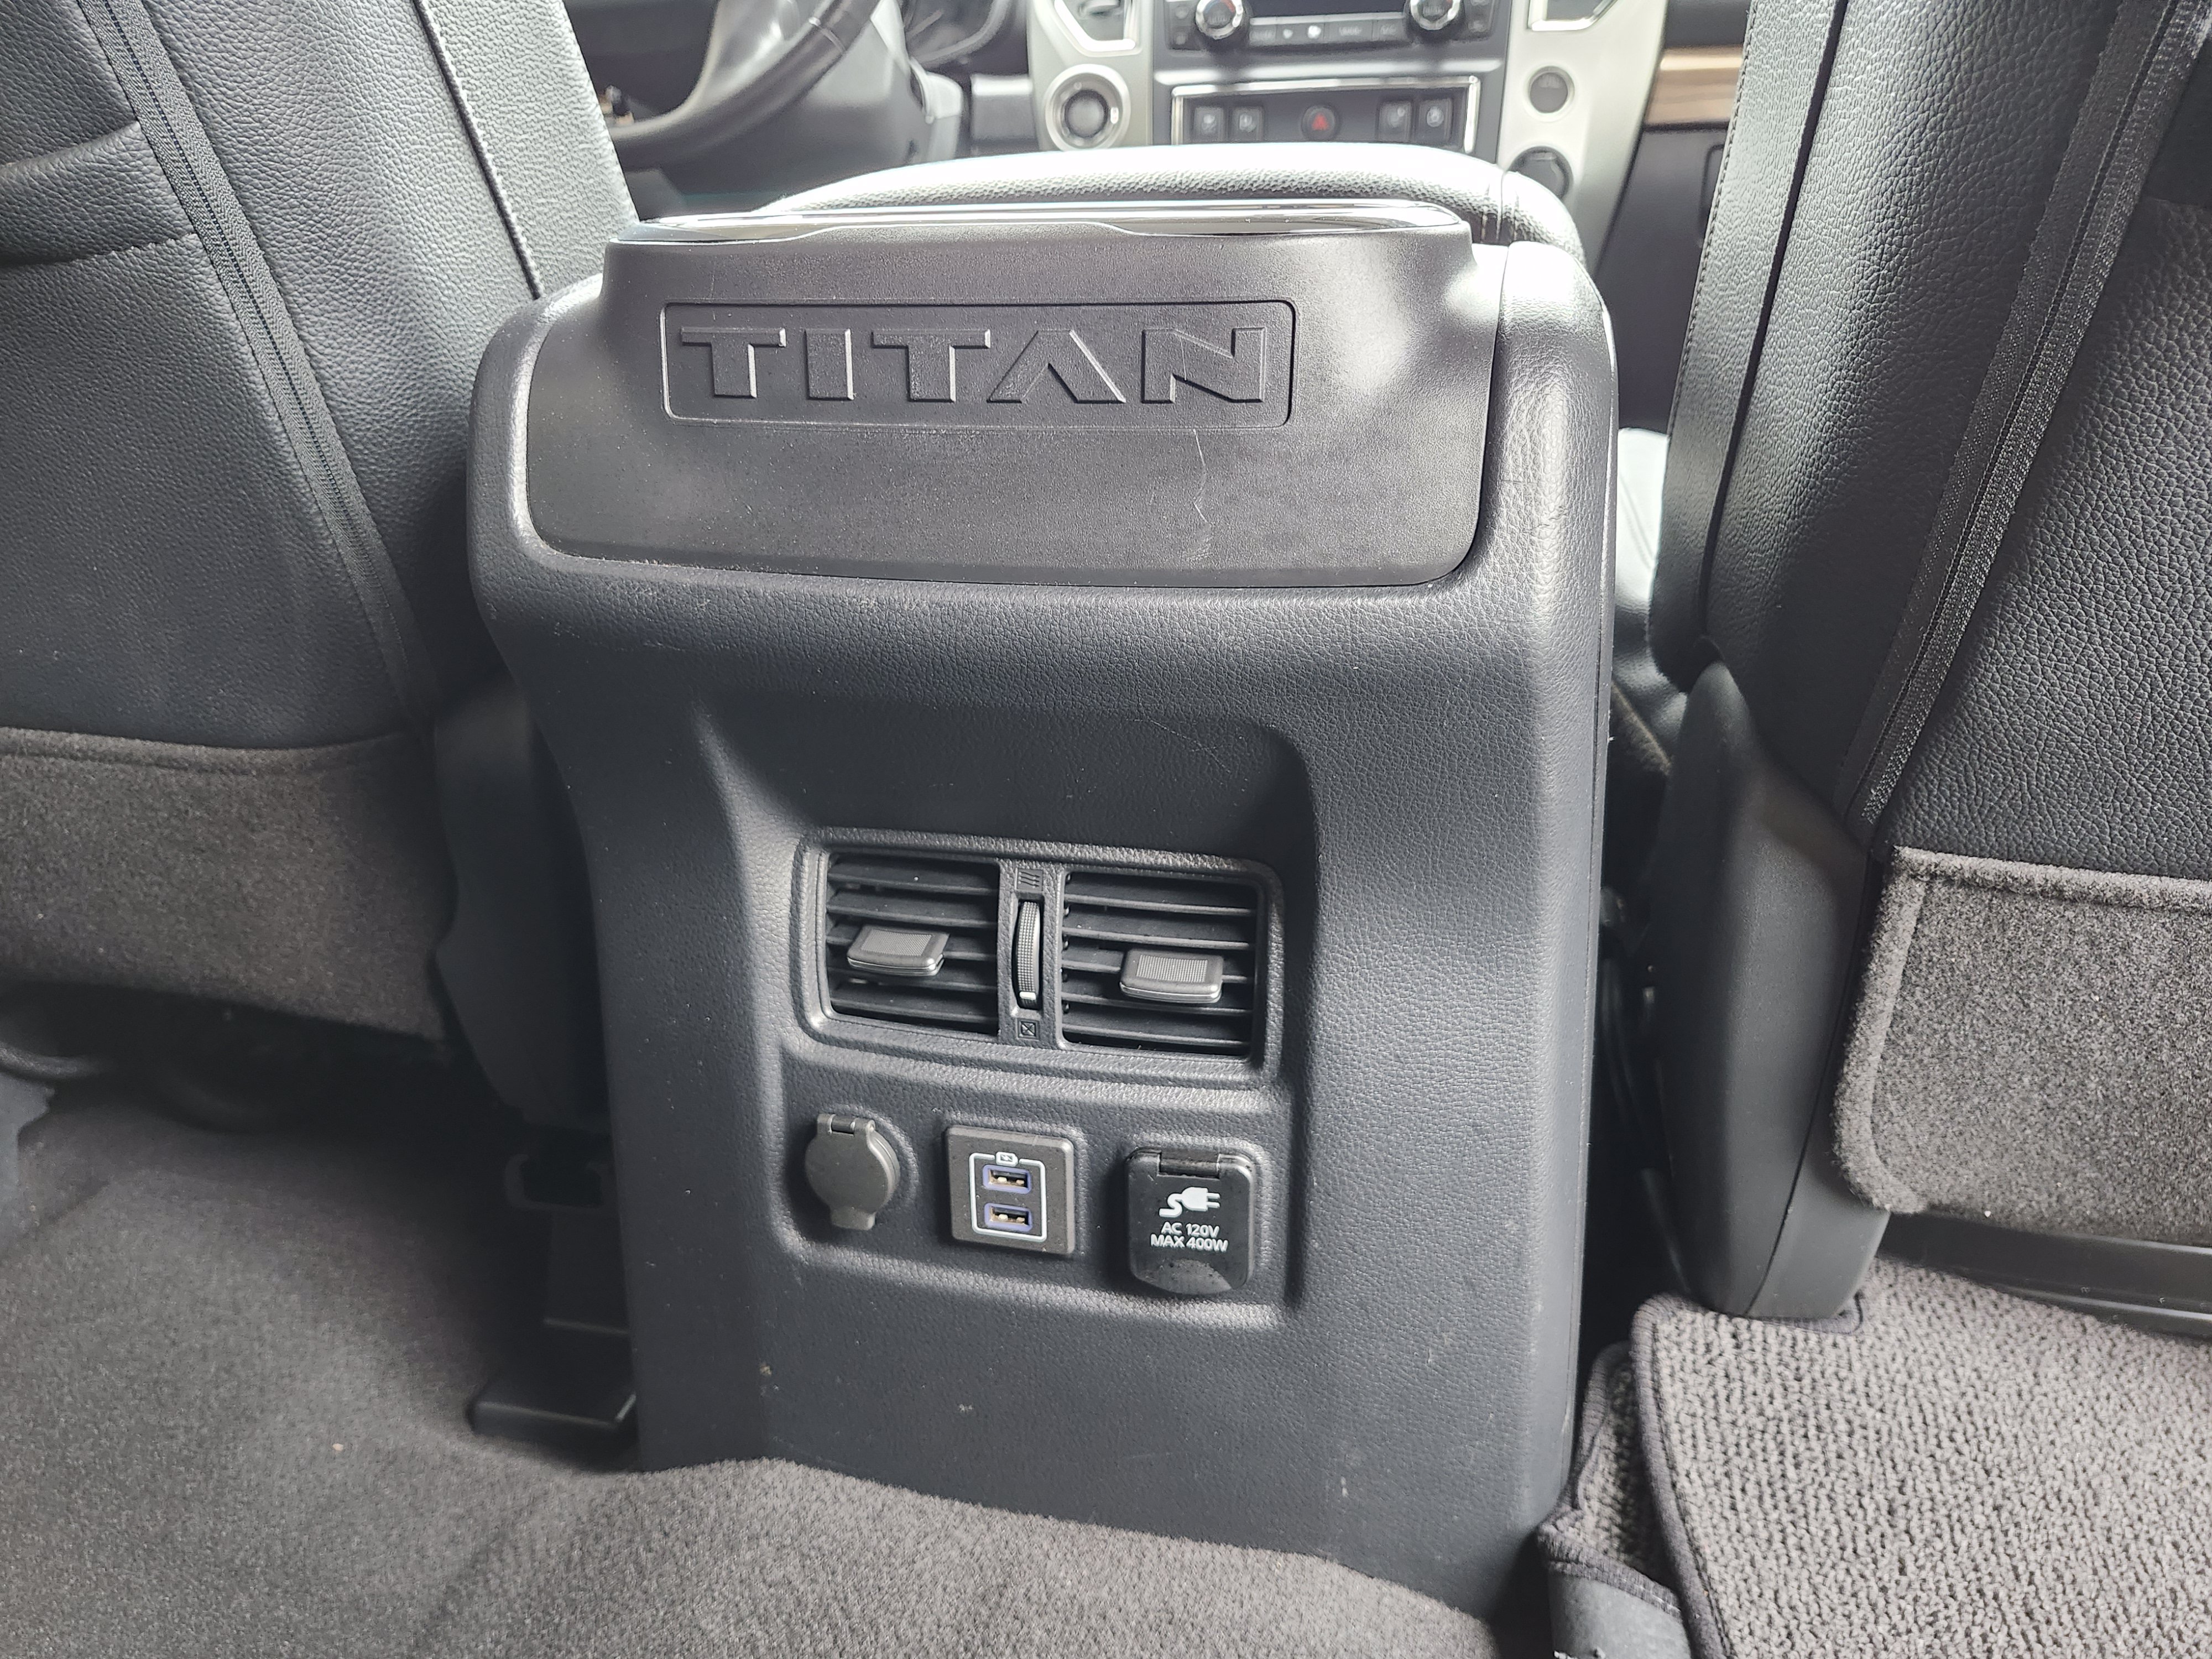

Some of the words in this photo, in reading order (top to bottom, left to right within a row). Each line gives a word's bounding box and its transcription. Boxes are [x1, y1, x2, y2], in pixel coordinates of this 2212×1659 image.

[681, 328, 1266, 403] TITAN
[1161, 1221, 1182, 1234] AC
[1186, 1223, 1219, 1238] 120V
[1150, 1234, 1185, 1248] MAX
[1186, 1237, 1228, 1252] 400W
